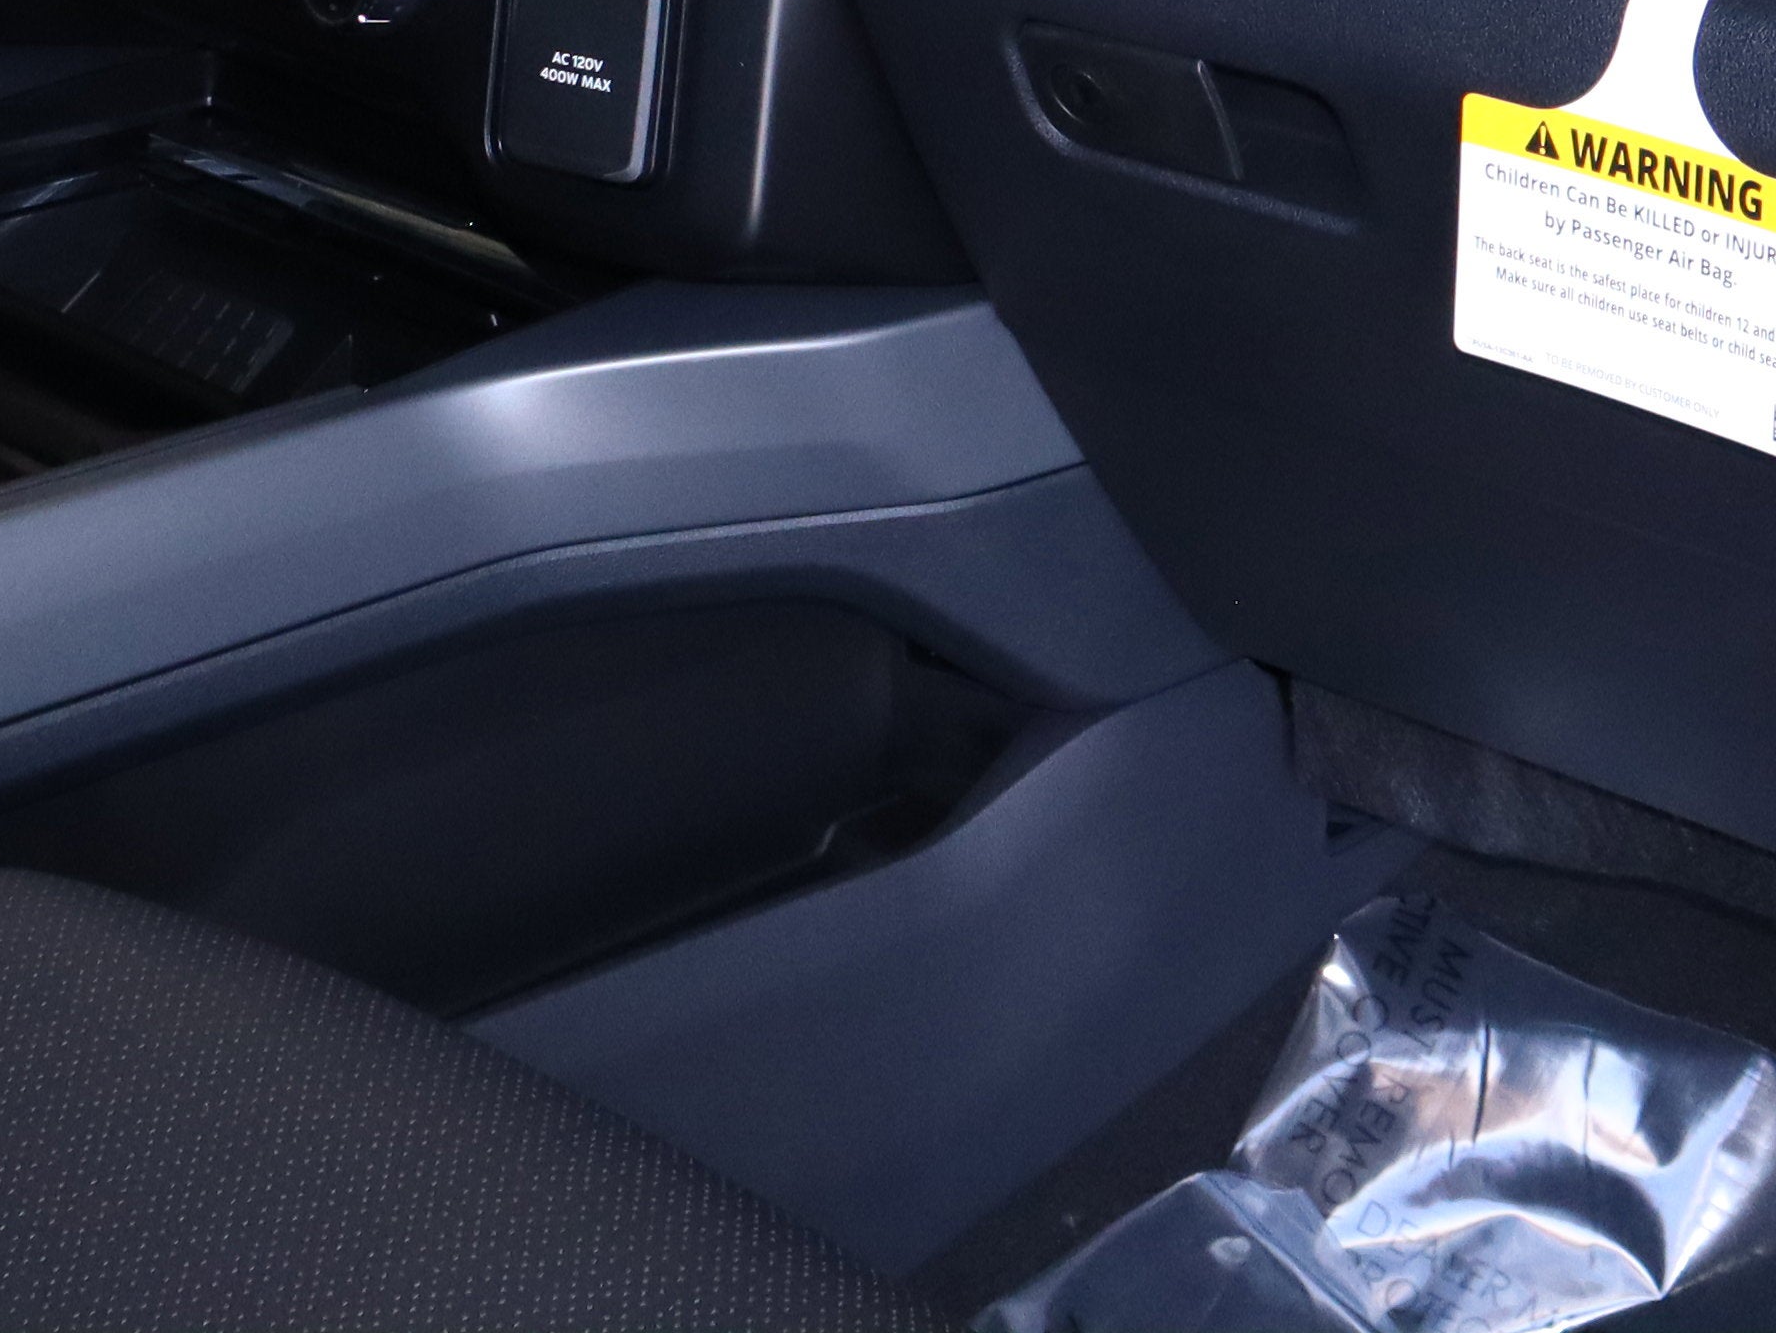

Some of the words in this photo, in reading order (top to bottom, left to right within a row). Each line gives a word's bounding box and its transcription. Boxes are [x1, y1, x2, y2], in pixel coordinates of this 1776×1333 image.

[539, 68, 579, 87] 400W
[580, 75, 612, 93] MAX
[551, 51, 571, 66] AC
[572, 54, 604, 73] 120V
[1485, 163, 1560, 197] Children
[1566, 185, 1600, 209] Can
[1606, 197, 1628, 217] Be
[1634, 205, 1695, 238] KILLED
[1701, 229, 1720, 245] or
[1570, 128, 1763, 221] WARNING
[1474, 236, 1495, 254] The
[1499, 243, 1525, 263] back
[1529, 252, 1553, 271] seat
[1557, 260, 1565, 274] is
[1570, 263, 1589, 281] the
[1593, 271, 1626, 293] safest
[1630, 284, 1661, 304] place
[1665, 292, 1681, 309] for
[1685, 299, 1732, 328] children
[1737, 317, 1749, 333] 12
[1753, 321, 1776, 342] and
[1545, 210, 1566, 236] by
[1572, 219, 1664, 261] Passenger
[1668, 249, 1695, 271] Air
[1701, 259, 1737, 288] Bag.
[1496, 266, 1528, 287] Make
[1532, 277, 1556, 296] sure
[1560, 283, 1574, 301] all
[1578, 290, 1625, 317] children
[1629, 308, 1648, 325] use
[1652, 314, 1677, 334] seat
[1681, 322, 1708, 345] belts
[1712, 334, 1724, 348] or
[1728, 335, 1756, 361] child
[1545, 352, 1559, 365] TO
[1561, 357, 1573, 370] BE
[1576, 363, 1623, 385] REMOVED
[1625, 377, 1637, 391] BY
[1639, 383, 1691, 409] CUSTOMER
[1693, 402, 1720, 420] ONLY
[1322, 1075, 1411, 1208] REMO
